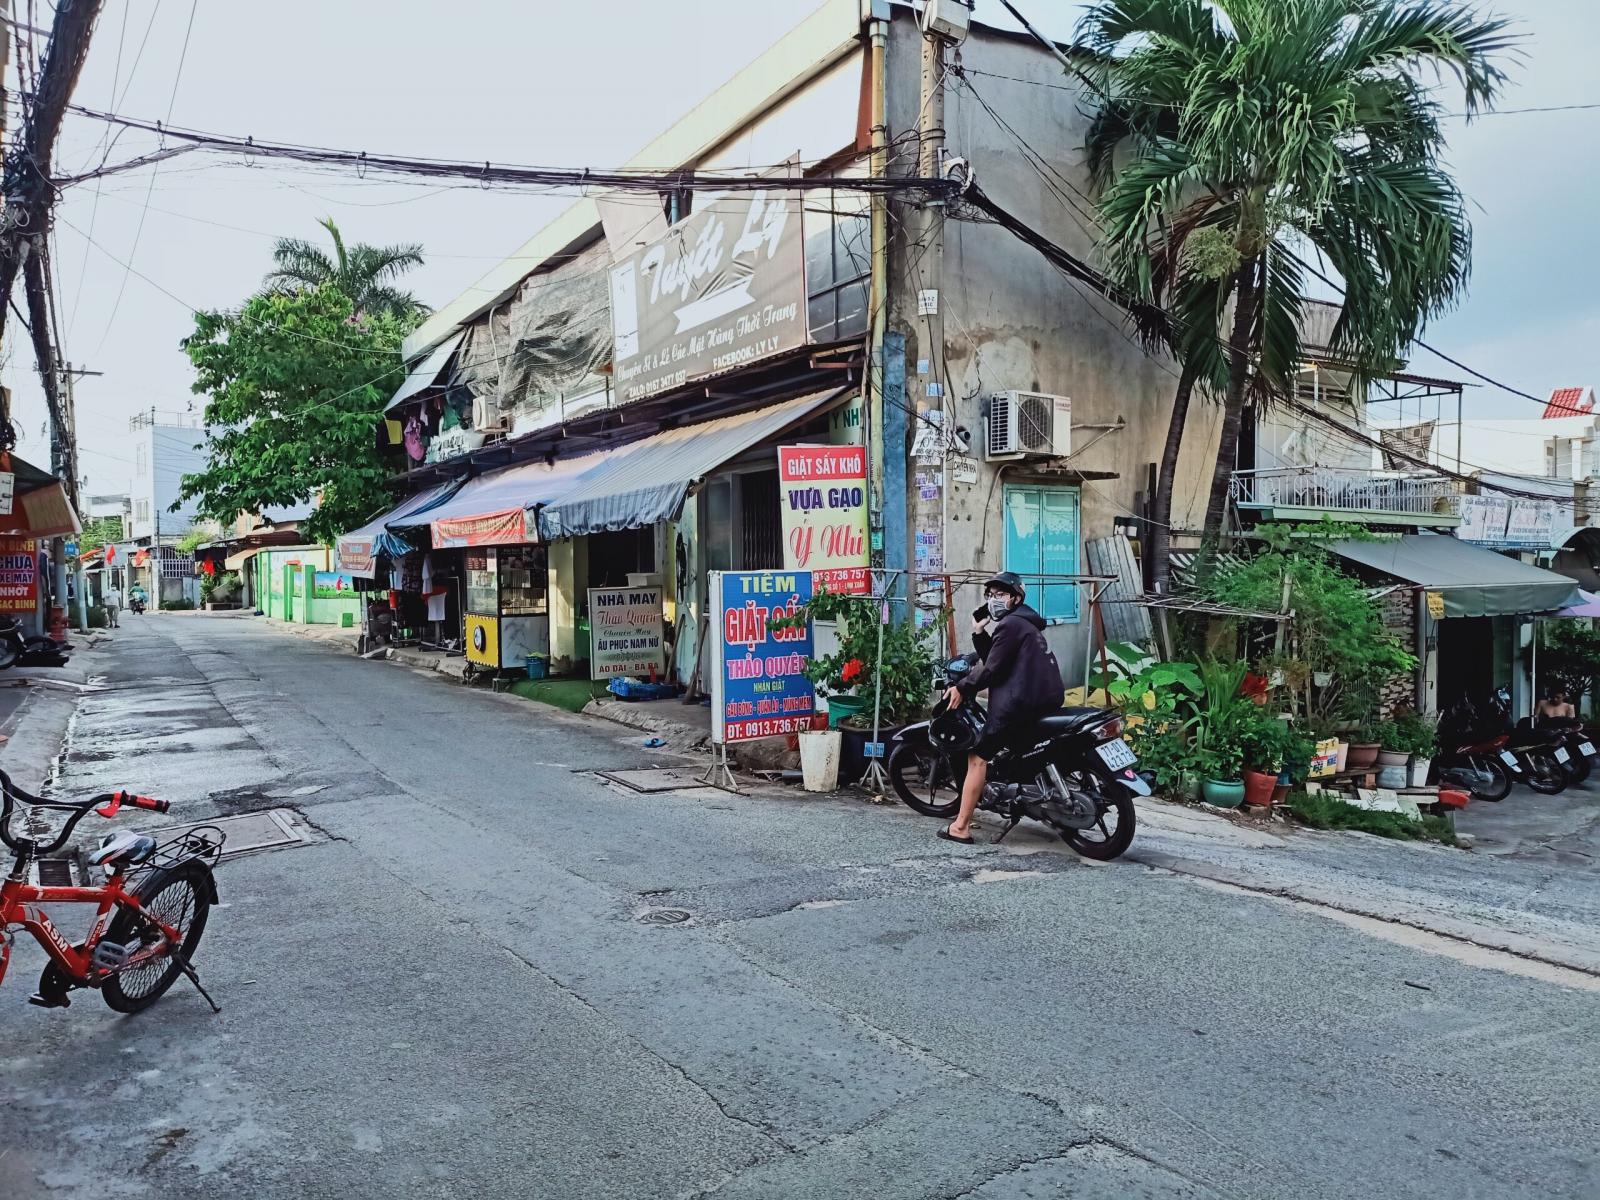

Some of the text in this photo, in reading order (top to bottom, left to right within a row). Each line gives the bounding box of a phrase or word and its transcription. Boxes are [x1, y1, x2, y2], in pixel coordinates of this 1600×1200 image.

[706, 327, 734, 349] Hàng
[736, 310, 762, 337] Thời
[763, 301, 798, 327] Trang
[712, 335, 780, 370] FACEBOOK: LY LY
[787, 454, 812, 479] GIẶT
[815, 451, 837, 476] SẤY
[839, 453, 862, 474] KHÔ
[788, 486, 864, 515] VỰA GẠO
[820, 525, 865, 558] Nhi
[740, 573, 796, 597] TIỆM
[832, 570, 849, 581] 736
[850, 568, 866, 580] 757
[597, 592, 657, 606] NHÀ MAY
[724, 600, 768, 652] GIẶT
[598, 635, 659, 652] ÂU PHỤC NAM NỮ
[726, 652, 764, 680] THẢO
[753, 680, 785, 694] NHẬN GIẶT
[727, 717, 812, 739] ĐT: 0913.736.757
[43, 919, 68, 953] ASM
